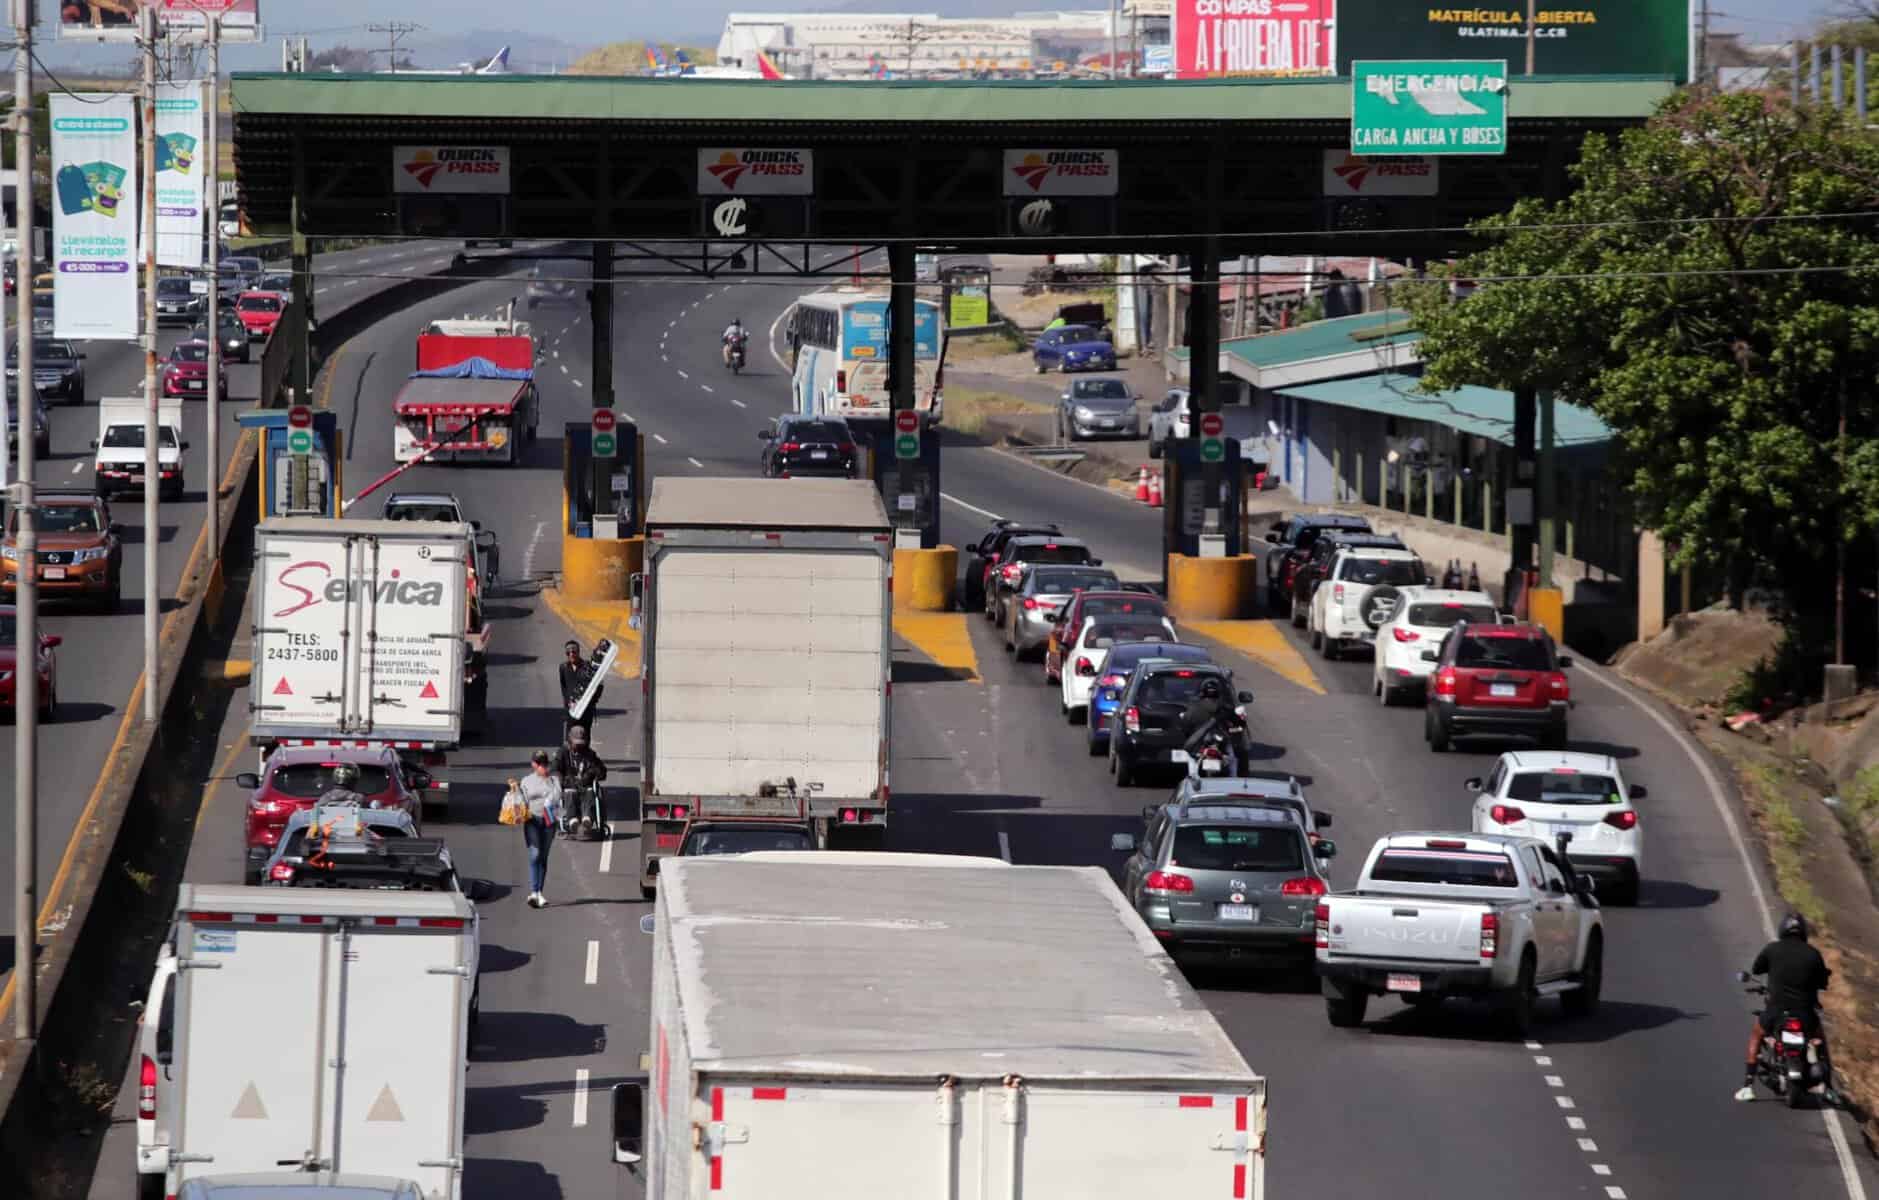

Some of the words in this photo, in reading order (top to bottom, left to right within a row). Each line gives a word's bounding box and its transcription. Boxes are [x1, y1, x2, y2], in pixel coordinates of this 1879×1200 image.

[1428, 7, 1522, 23] MATRÍCULA
[1196, 19, 1209, 72] A
[1213, 19, 1294, 71] PRUEBA
[1354, 128, 1398, 145] CARGA
[1403, 128, 1447, 145] ANCHA
[1450, 128, 1459, 144] Y
[437, 148, 496, 162] QUICK
[742, 150, 800, 163] QUICK
[1046, 152, 1105, 165] QUICK
[447, 162, 502, 174] PASS
[751, 164, 805, 175] PASS
[1056, 165, 1112, 176] PASS
[1376, 164, 1432, 176] PASS
[74, 247, 127, 258] recargar
[272, 561, 444, 618] Servica
[288, 633, 321, 646] TELS:
[267, 647, 339, 662] 2437-5800
[399, 648, 420, 656] CARGA
[1362, 926, 1448, 945] ISUZU
